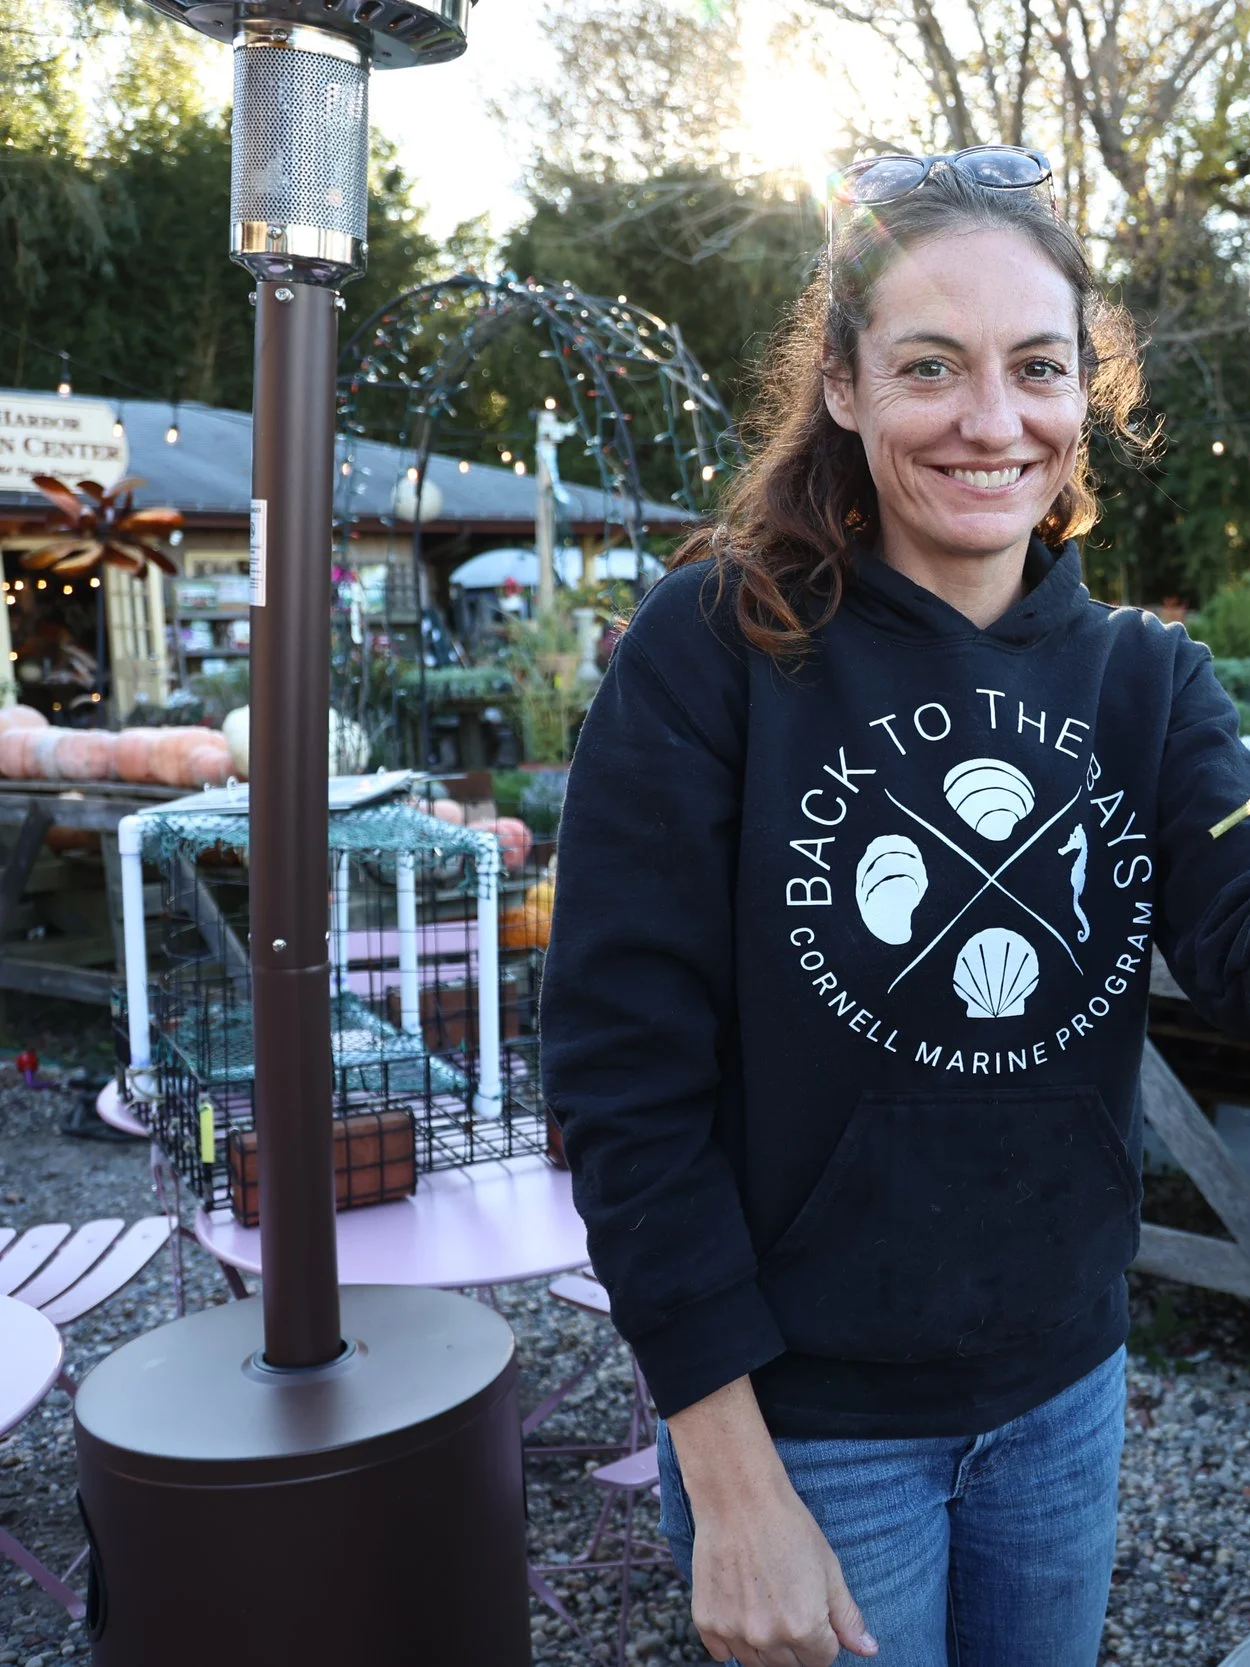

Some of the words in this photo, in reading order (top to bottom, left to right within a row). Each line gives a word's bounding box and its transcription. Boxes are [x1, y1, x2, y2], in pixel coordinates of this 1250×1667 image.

[24, 437, 122, 461] CENTER
[785, 746, 877, 906] BACK
[868, 702, 952, 756] TO
[975, 688, 1091, 760] THE
[1086, 752, 1153, 889] BAYS
[789, 927, 898, 1053] CORNELL
[914, 1041, 1048, 1075] MARINE
[1055, 901, 1153, 1051] PROGRAM
